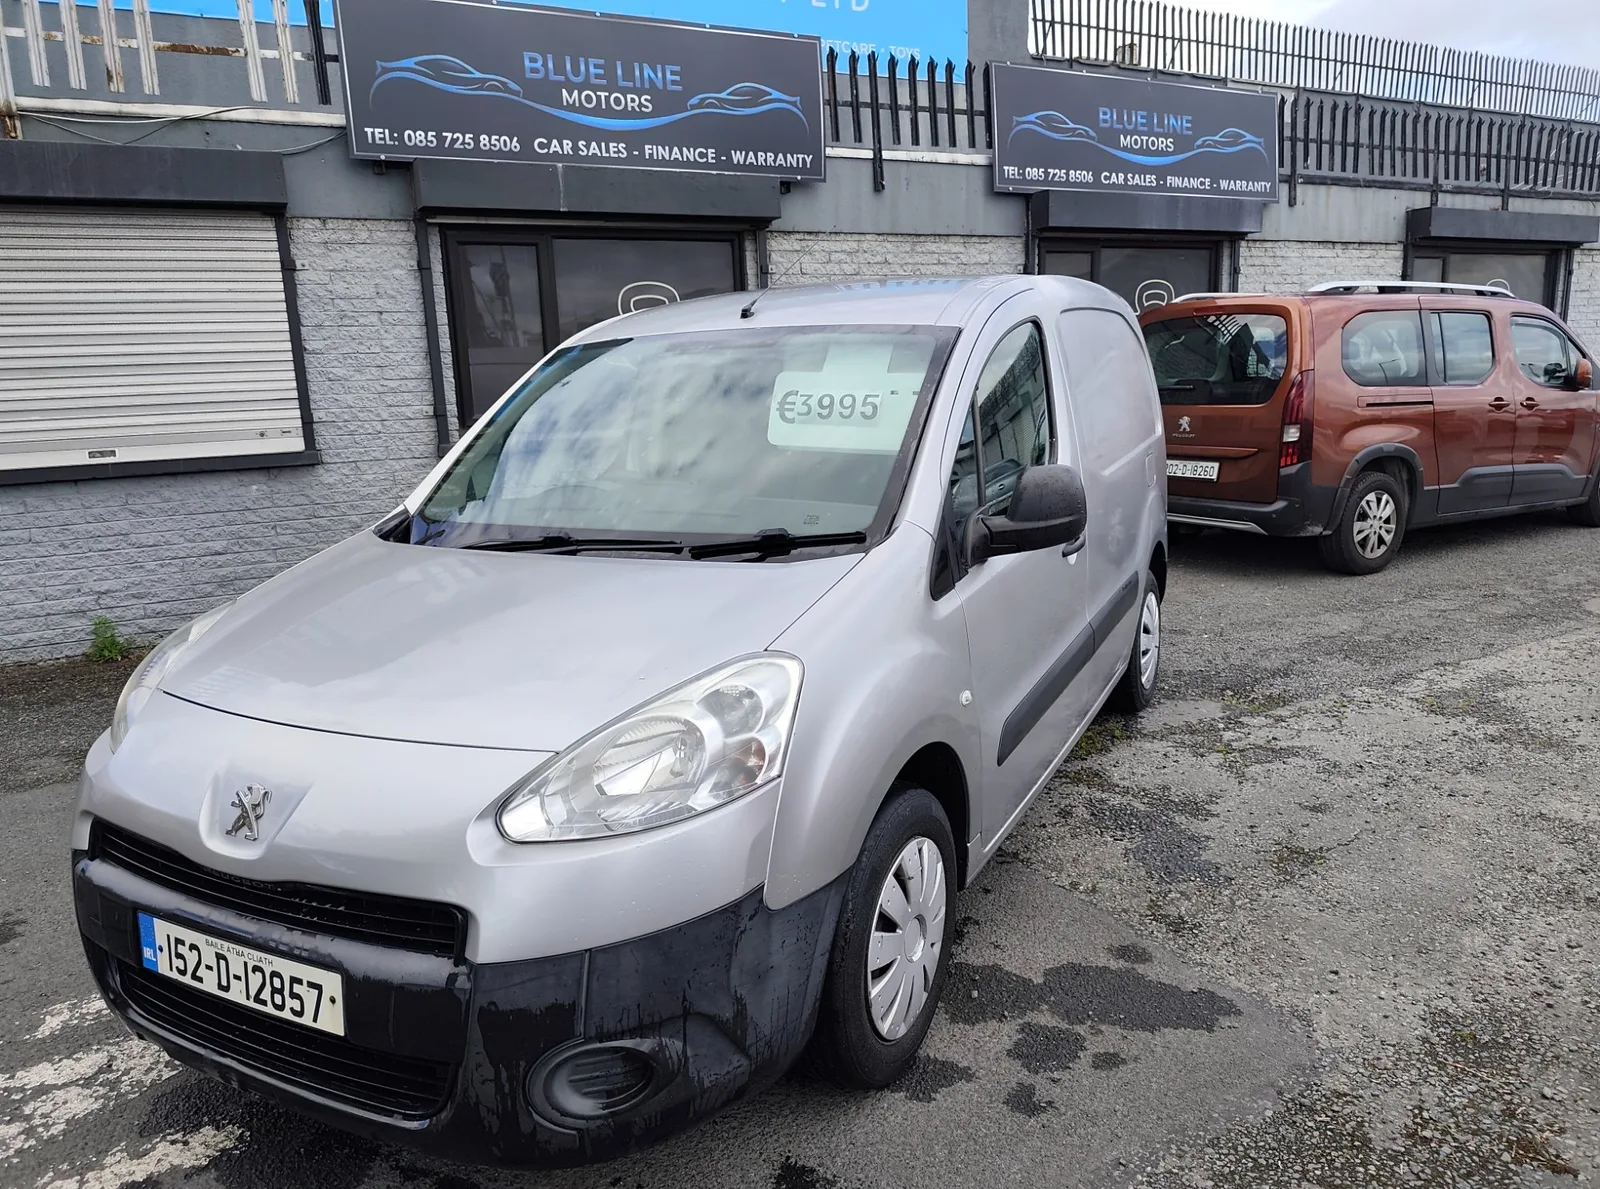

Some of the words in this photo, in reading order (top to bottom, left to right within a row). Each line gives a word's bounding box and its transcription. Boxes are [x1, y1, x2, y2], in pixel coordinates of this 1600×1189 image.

[888, 45, 921, 60] TOYS
[522, 51, 606, 87] BLUE
[615, 60, 683, 92] LINE
[561, 88, 654, 114] MOTORS
[1098, 106, 1148, 131] BLUE
[1153, 112, 1193, 136] LINE
[363, 127, 399, 147] TEL:
[403, 129, 438, 149] 085
[441, 131, 475, 151] 725
[478, 134, 521, 153] 8506
[533, 137, 575, 156] CAR
[577, 140, 628, 159] SALES
[644, 144, 717, 164] FINANCE
[730, 149, 814, 169] WARRANTY
[1119, 134, 1175, 152] MOTORS
[1003, 165, 1023, 180] TEL:
[1025, 167, 1045, 181] 085
[1047, 168, 1067, 182] 725
[1069, 169, 1094, 183] 8506
[1100, 171, 1125, 185] CAR
[1127, 173, 1157, 187] SALES
[1166, 175, 1211, 190] FINANCE
[1219, 178, 1272, 193] WARRANTY
[775, 389, 880, 425] €3995
[143, 946, 157, 963] IRL
[204, 938, 225, 952] BAILE
[246, 952, 274, 967] CLIATH
[166, 933, 324, 1024] 152-D-12857
